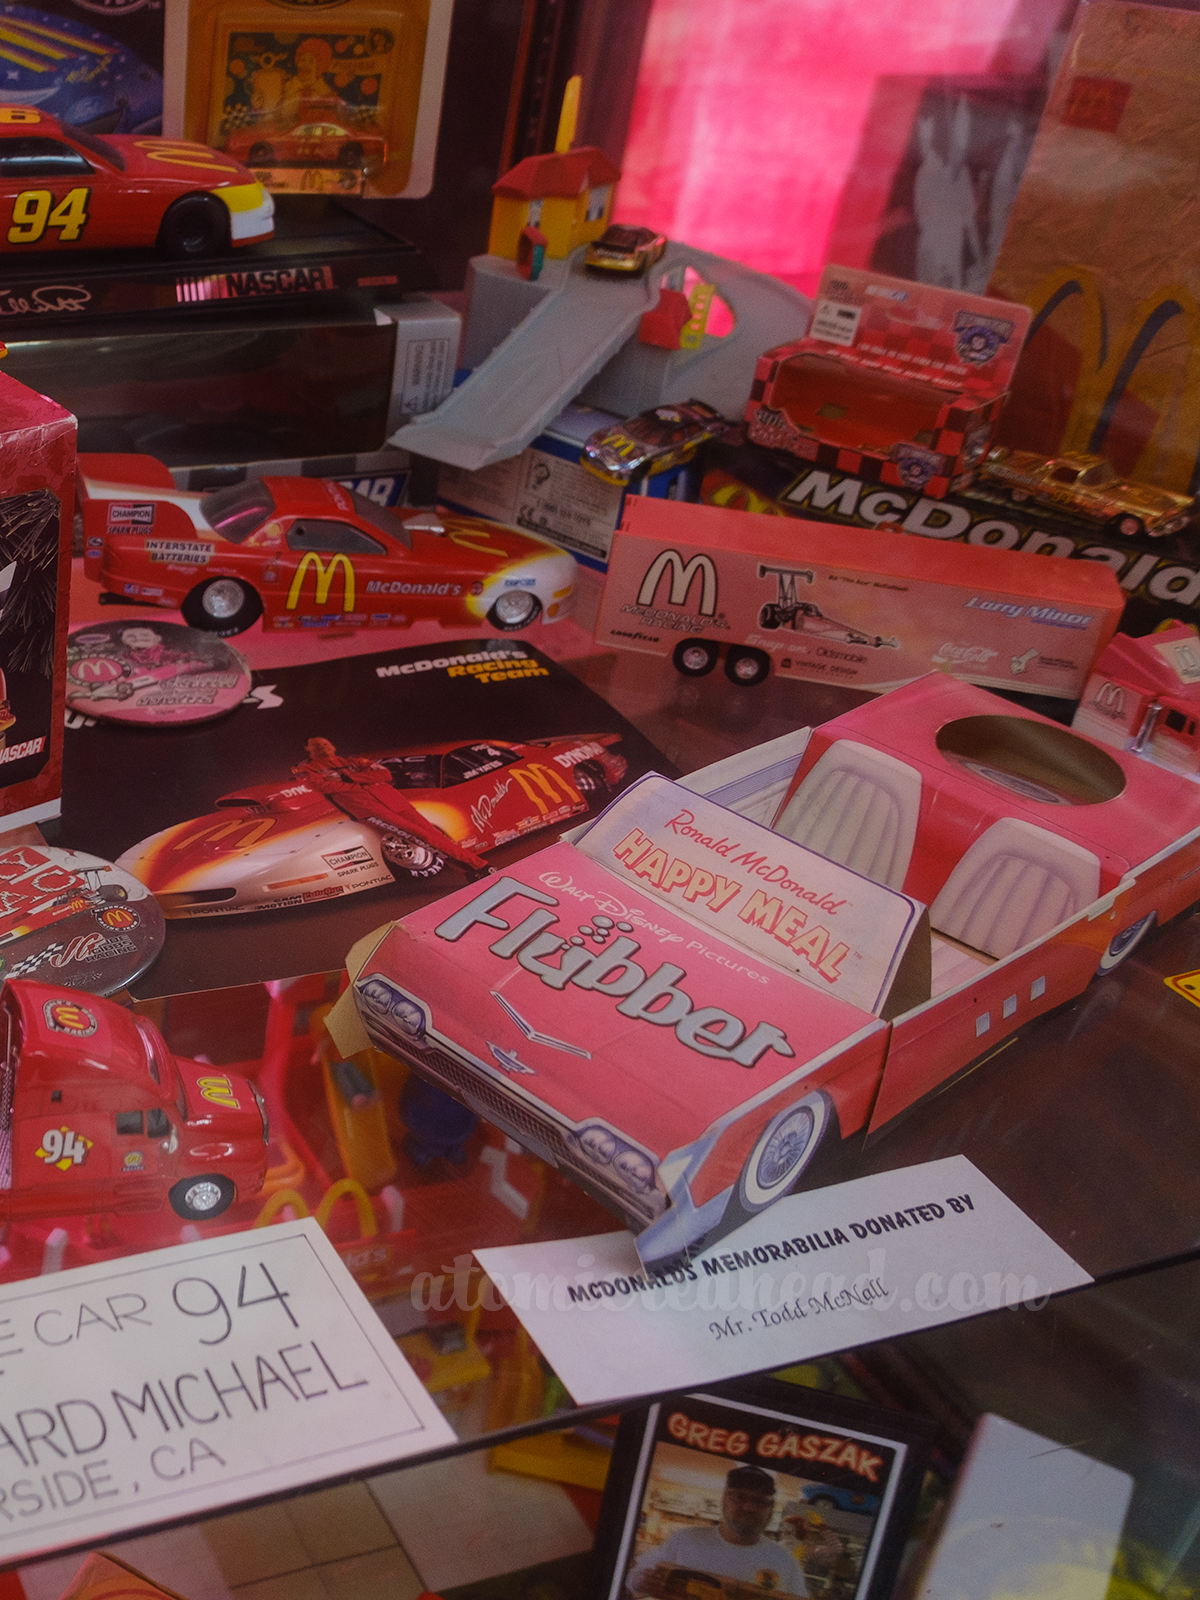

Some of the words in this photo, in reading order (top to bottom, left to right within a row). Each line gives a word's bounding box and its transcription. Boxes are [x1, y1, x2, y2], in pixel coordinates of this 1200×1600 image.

[7, 188, 92, 243] 94
[226, 267, 327, 299] NASCAR
[112, 504, 150, 518] CHAMPION
[107, 525, 131, 534] SPARK
[146, 541, 213, 553] INTERSTATE
[151, 551, 208, 564] BATTERIES
[366, 579, 463, 597] McDonald's
[963, 596, 1026, 619] Larry
[1025, 604, 1094, 626] Minor
[640, 616, 704, 635] RACING
[376, 650, 529, 678] McDonald's
[816, 646, 869, 664] Oldsmobile
[447, 658, 540, 679] Racing
[474, 667, 550, 684] Team
[830, 665, 859, 676] DESIGN
[477, 759, 504, 776] YATES
[328, 850, 369, 867] CHAMPION
[337, 867, 359, 879] SPARK
[359, 861, 380, 874] PLUGS
[664, 808, 736, 860] Ronald
[736, 850, 846, 917] McDonald
[351, 874, 394, 890] PONTIAC
[612, 826, 742, 915] HAPPY
[737, 888, 854, 985] MEAL
[685, 939, 771, 986] Pictures
[41, 1128, 87, 1165] 94
[701, 1228, 851, 1276] MEMORABILIA
[849, 1202, 945, 1240] DONATED
[945, 1194, 976, 1220] BY
[32, 1292, 154, 1348] CAR
[171, 1261, 301, 1346] 94
[708, 1317, 753, 1341] Mr.
[752, 1299, 807, 1329] Todd
[806, 1277, 891, 1316] McNall
[110, 1340, 370, 1442] MICHAEL
[666, 1410, 752, 1457] GREG
[755, 1429, 886, 1482] GASZAK
[150, 1437, 227, 1483] CA
